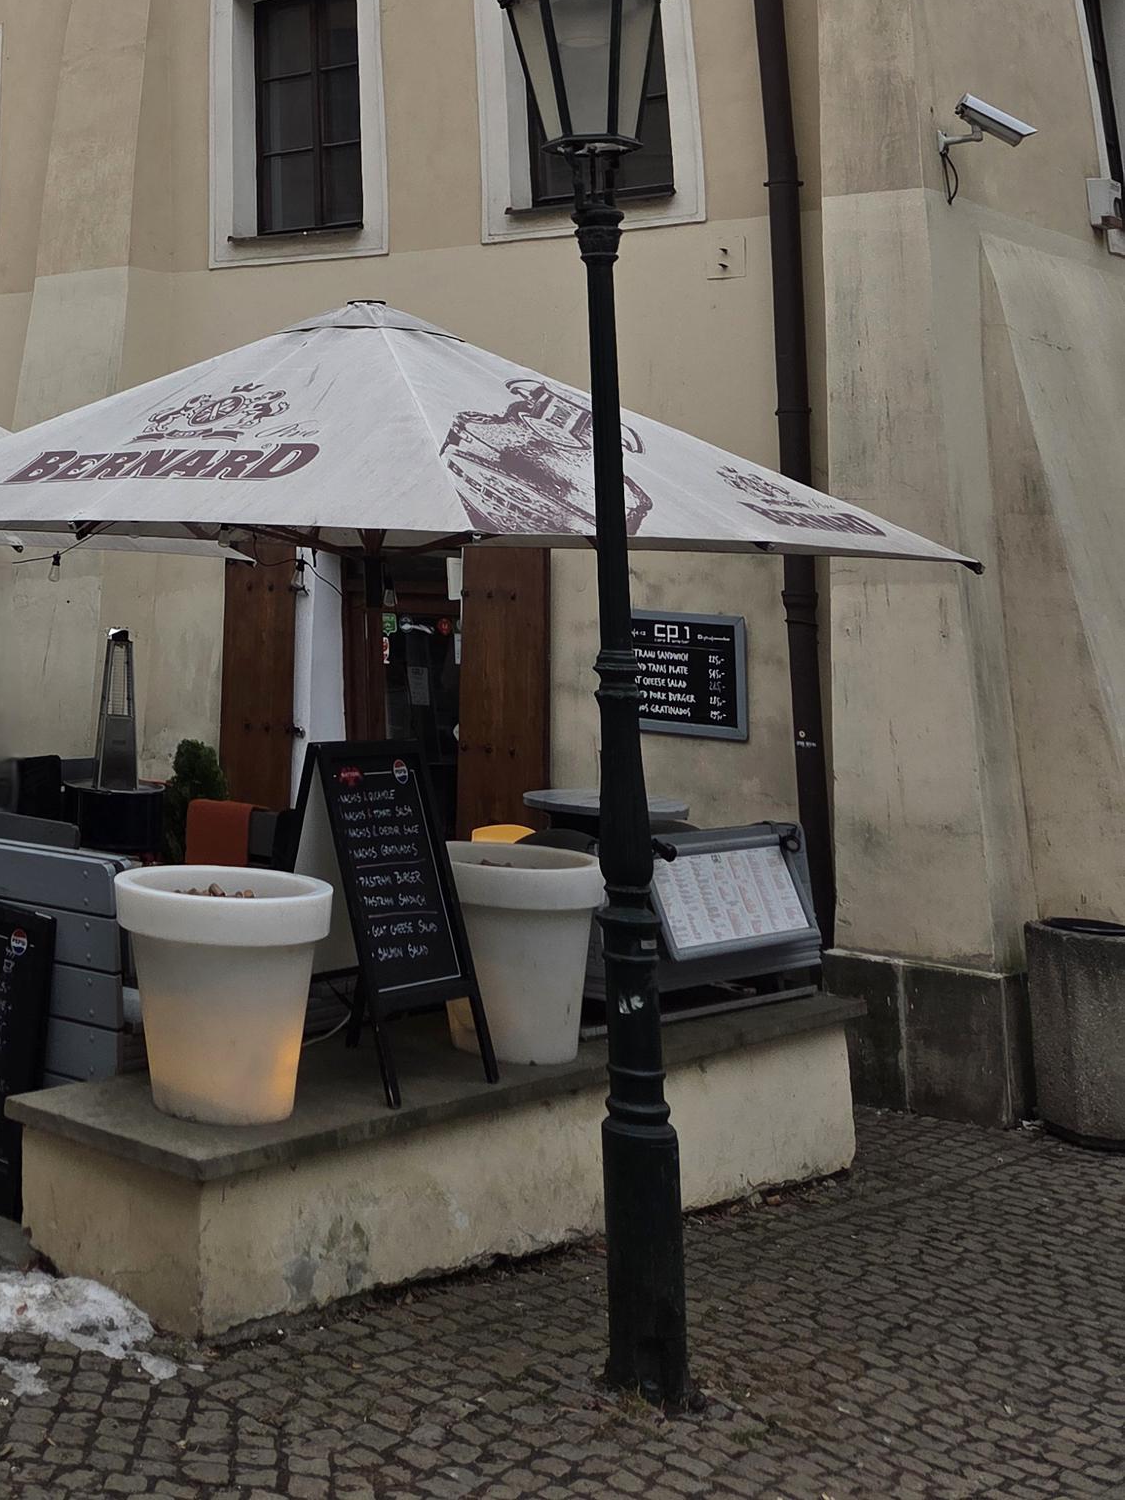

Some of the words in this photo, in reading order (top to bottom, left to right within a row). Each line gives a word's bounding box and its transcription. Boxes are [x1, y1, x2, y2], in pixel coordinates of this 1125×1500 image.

[737, 501, 887, 536] BERNARD
[633, 648, 656, 659] TRAMI
[657, 650, 689, 662] SANDWICH
[647, 663, 666, 674] TAPAS
[668, 664, 689, 675] PLATE
[643, 676, 666, 687] CHEESE
[667, 678, 688, 689] SALAD
[649, 690, 667, 701] PORK
[668, 691, 697, 704] BURGER
[650, 704, 691, 717] GRATINADOS
